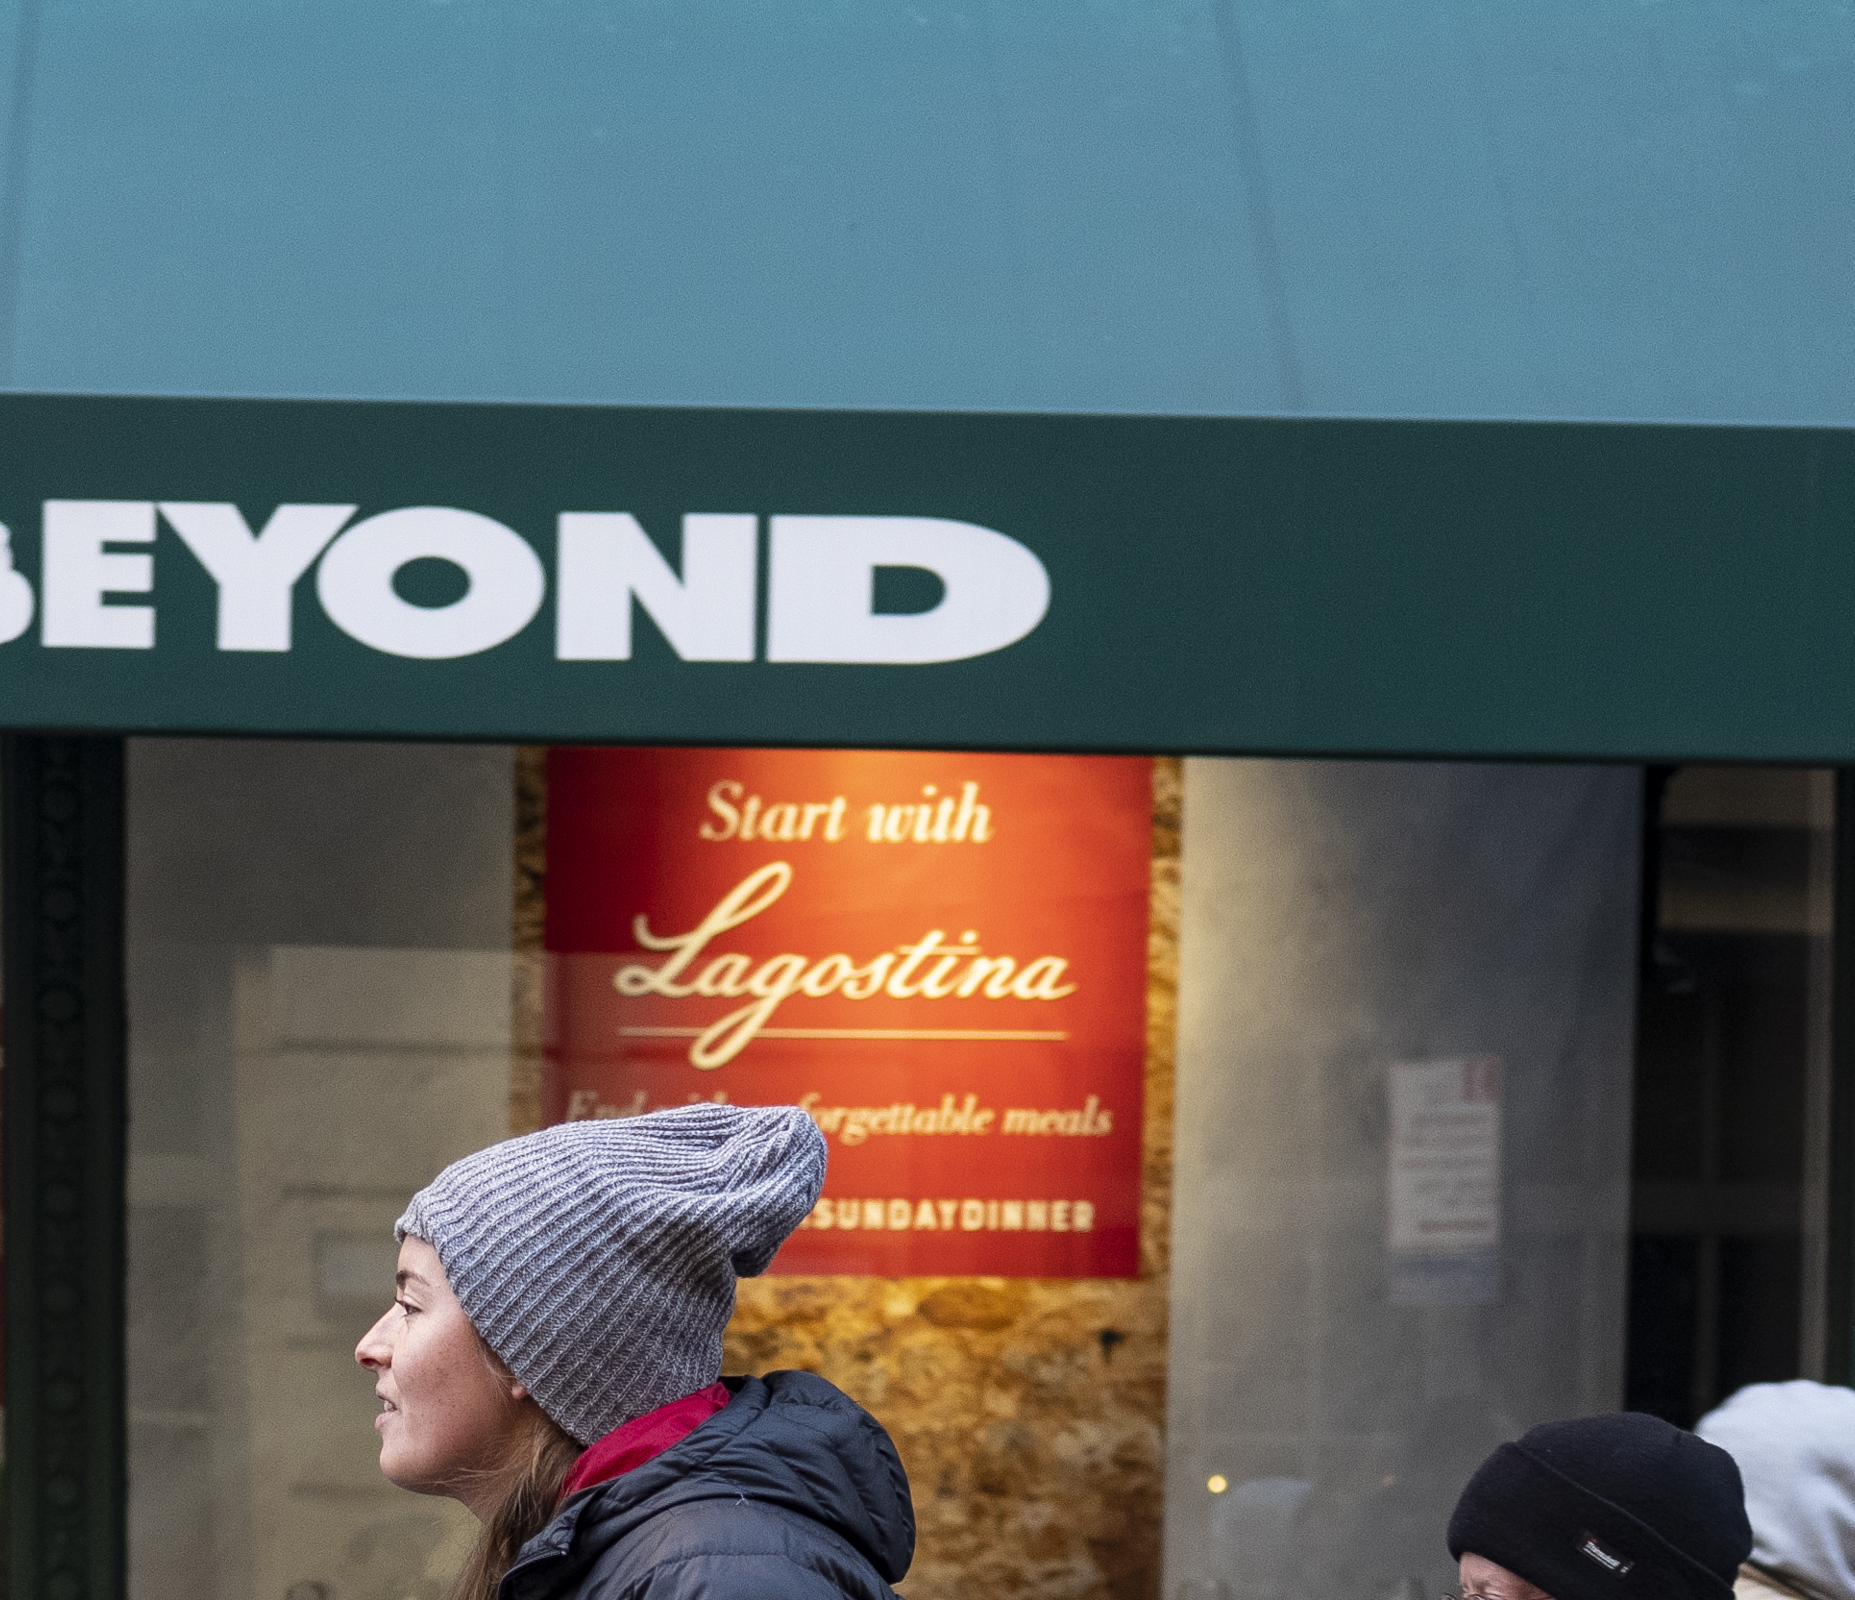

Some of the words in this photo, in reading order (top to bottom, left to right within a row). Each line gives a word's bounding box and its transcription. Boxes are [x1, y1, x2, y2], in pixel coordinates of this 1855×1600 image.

[699, 779, 847, 842] Start
[865, 780, 994, 843] with
[612, 860, 1080, 1070] Lagostina
[799, 1091, 998, 1146] orgettable
[1001, 1095, 1114, 1138] meals
[800, 1199, 1096, 1234] SUNDAYDINNER
